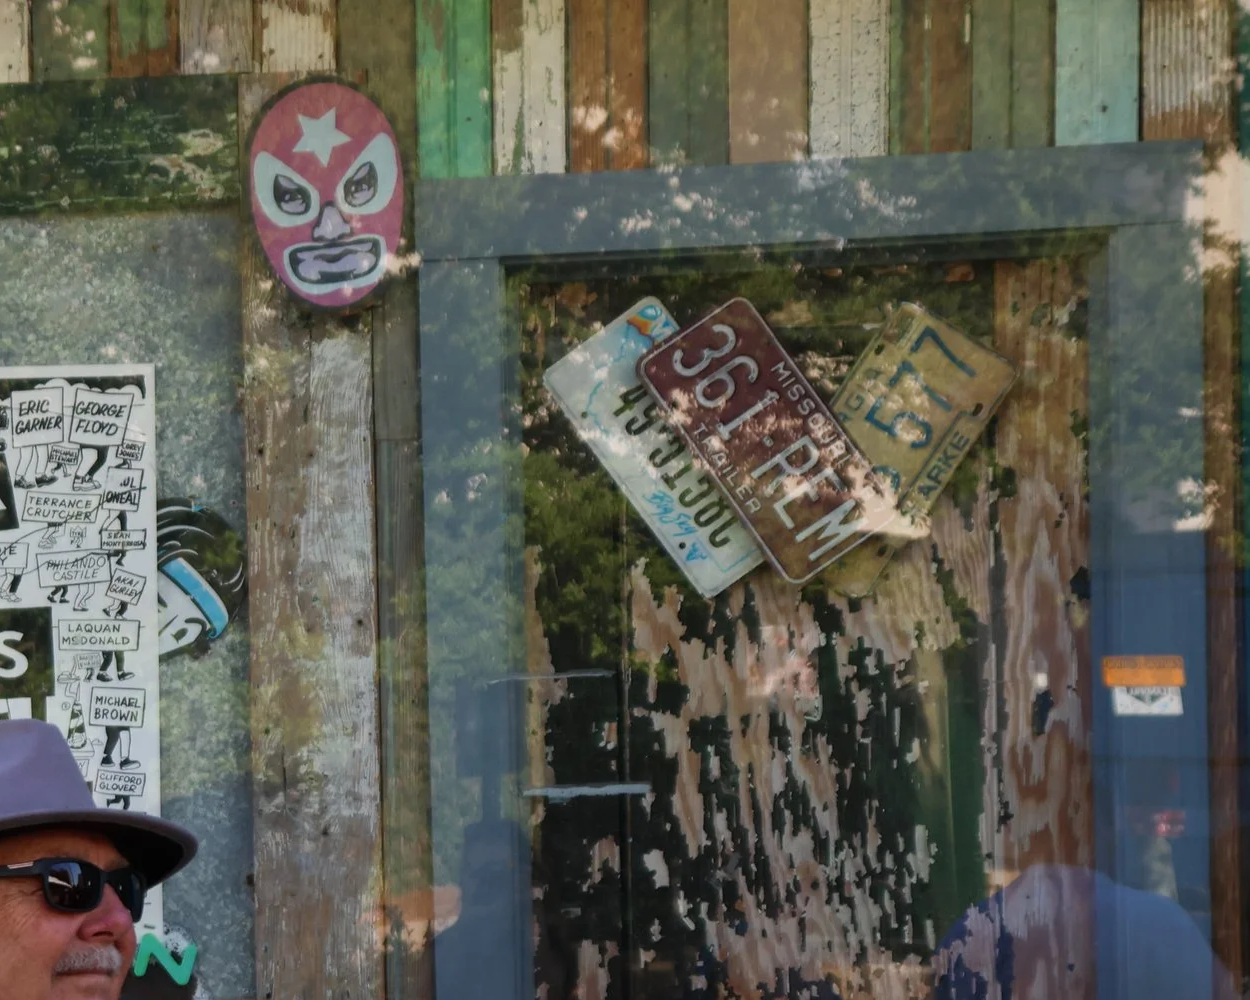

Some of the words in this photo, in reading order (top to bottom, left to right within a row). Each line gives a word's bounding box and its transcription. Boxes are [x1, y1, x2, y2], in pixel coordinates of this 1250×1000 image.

[19, 399, 50, 417] ERIC
[75, 400, 127, 418] GEORGE
[770, 360, 851, 465] MISSOURI
[15, 415, 63, 435] GARNER
[76, 422, 119, 437] FLOYD
[693, 424, 762, 514] TRAILER
[29, 496, 93, 510] TERRANCE
[26, 507, 93, 521] CRUTCHER
[46, 555, 107, 571] PHILANDO
[53, 568, 99, 582] CASTILE
[114, 575, 140, 587] AKAI
[110, 583, 142, 598] GURLEY
[68, 623, 121, 633] LAQUAN
[95, 696, 141, 709] MICHAEL
[94, 708, 139, 722] BROWN
[99, 773, 142, 786] CLIFFORD
[100, 783, 138, 793] GLOVER
[133, 933, 197, 985] N
